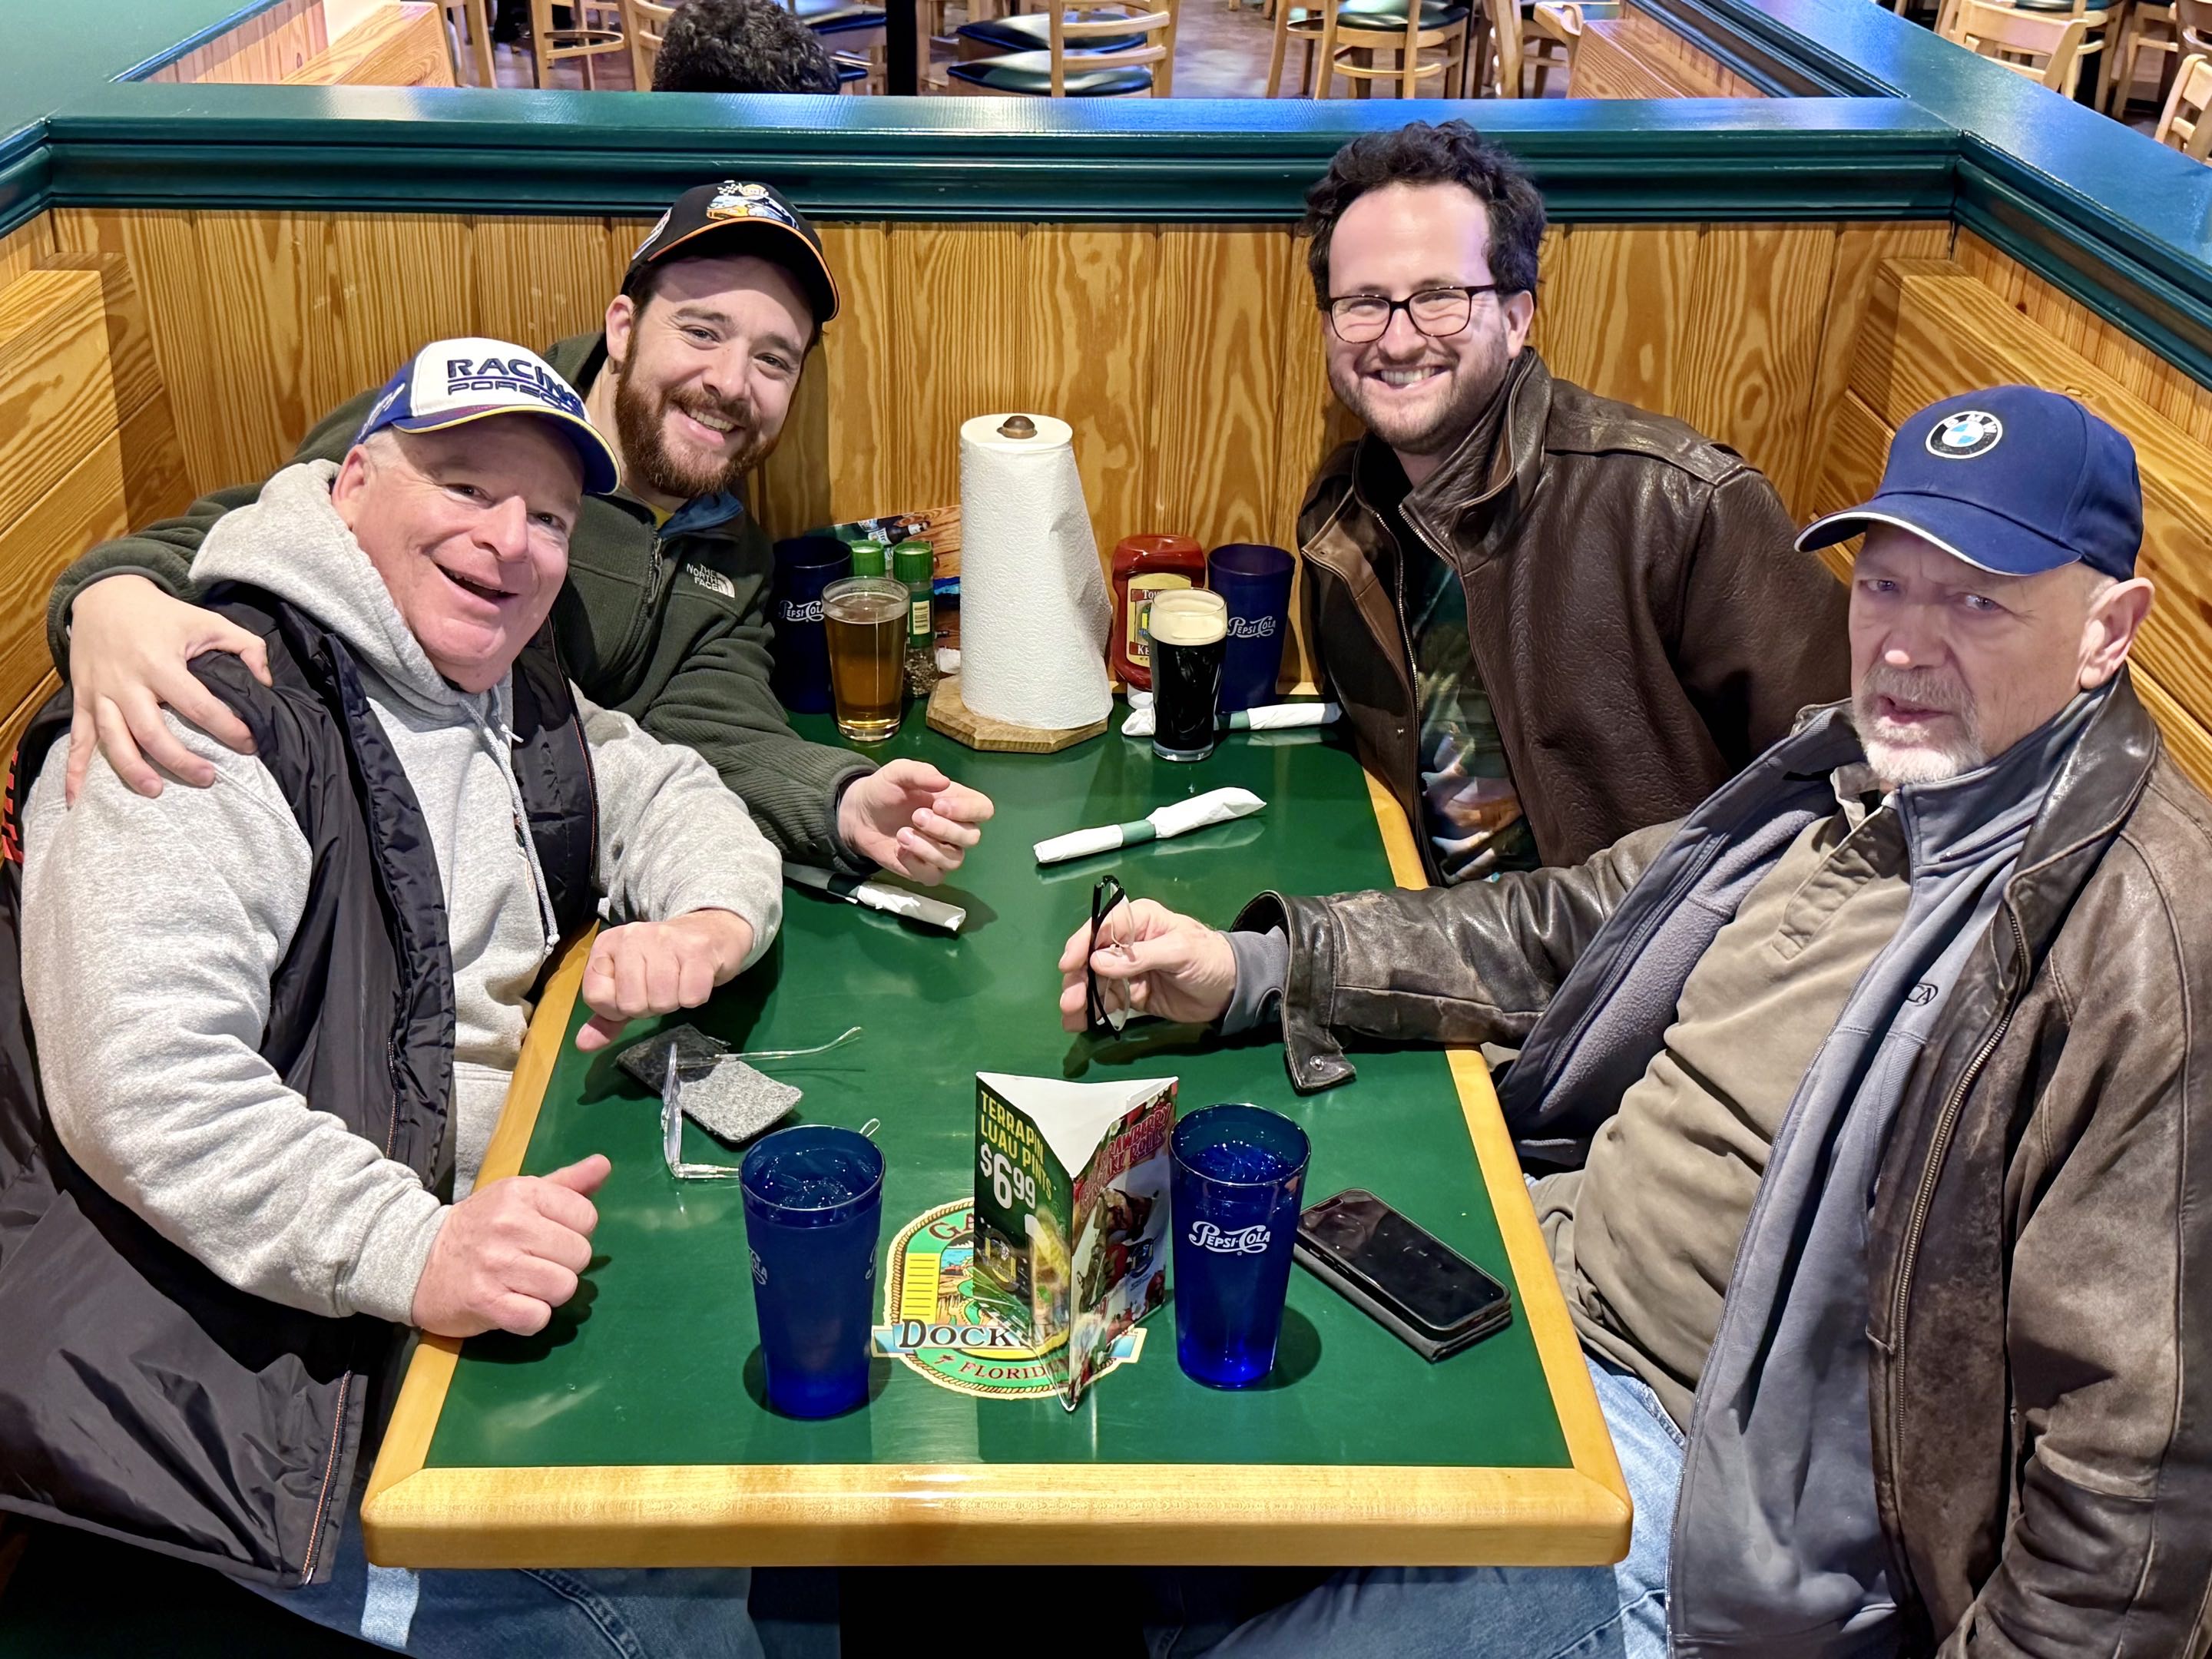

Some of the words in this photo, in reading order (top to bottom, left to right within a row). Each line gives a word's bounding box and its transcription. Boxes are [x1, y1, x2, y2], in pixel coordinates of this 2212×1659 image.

[1942, 414, 1997, 433] BMW
[687, 563, 717, 584] NORTH
[700, 563, 717, 578] THE
[694, 576, 719, 591] FACE
[981, 1090, 1044, 1164] TERRAPIN
[981, 1114, 1018, 1159] LUAU
[1022, 1147, 1051, 1200] PINTS
[899, 1319, 1015, 1349] DOCK
[959, 1361, 1047, 1379] FLORID
